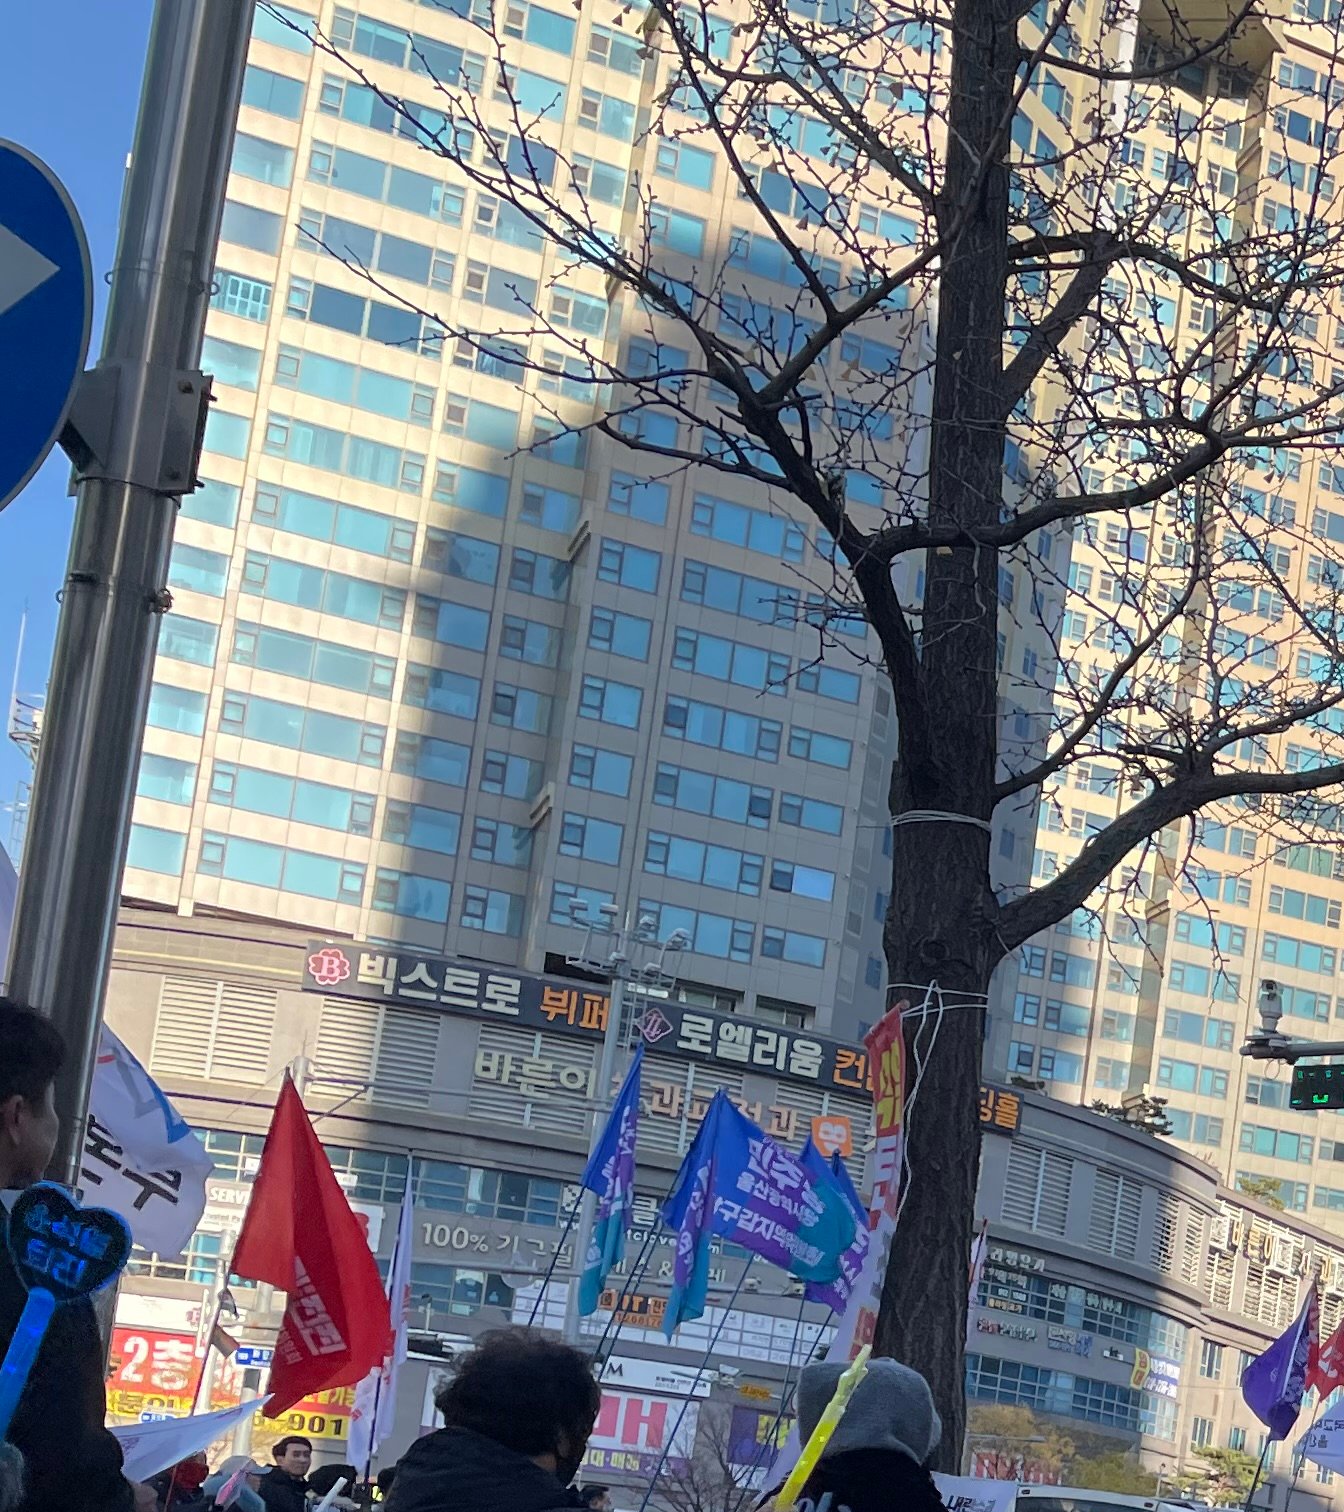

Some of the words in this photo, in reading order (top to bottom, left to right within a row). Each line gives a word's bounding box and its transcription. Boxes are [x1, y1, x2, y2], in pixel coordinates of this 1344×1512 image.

[356, 951, 522, 1017] 빅스트로
[676, 1012, 827, 1080] 로엘리움
[474, 1051, 597, 1099] 바른이
[421, 1222, 489, 1253] 100%
[119, 1335, 191, 1391] 2층
